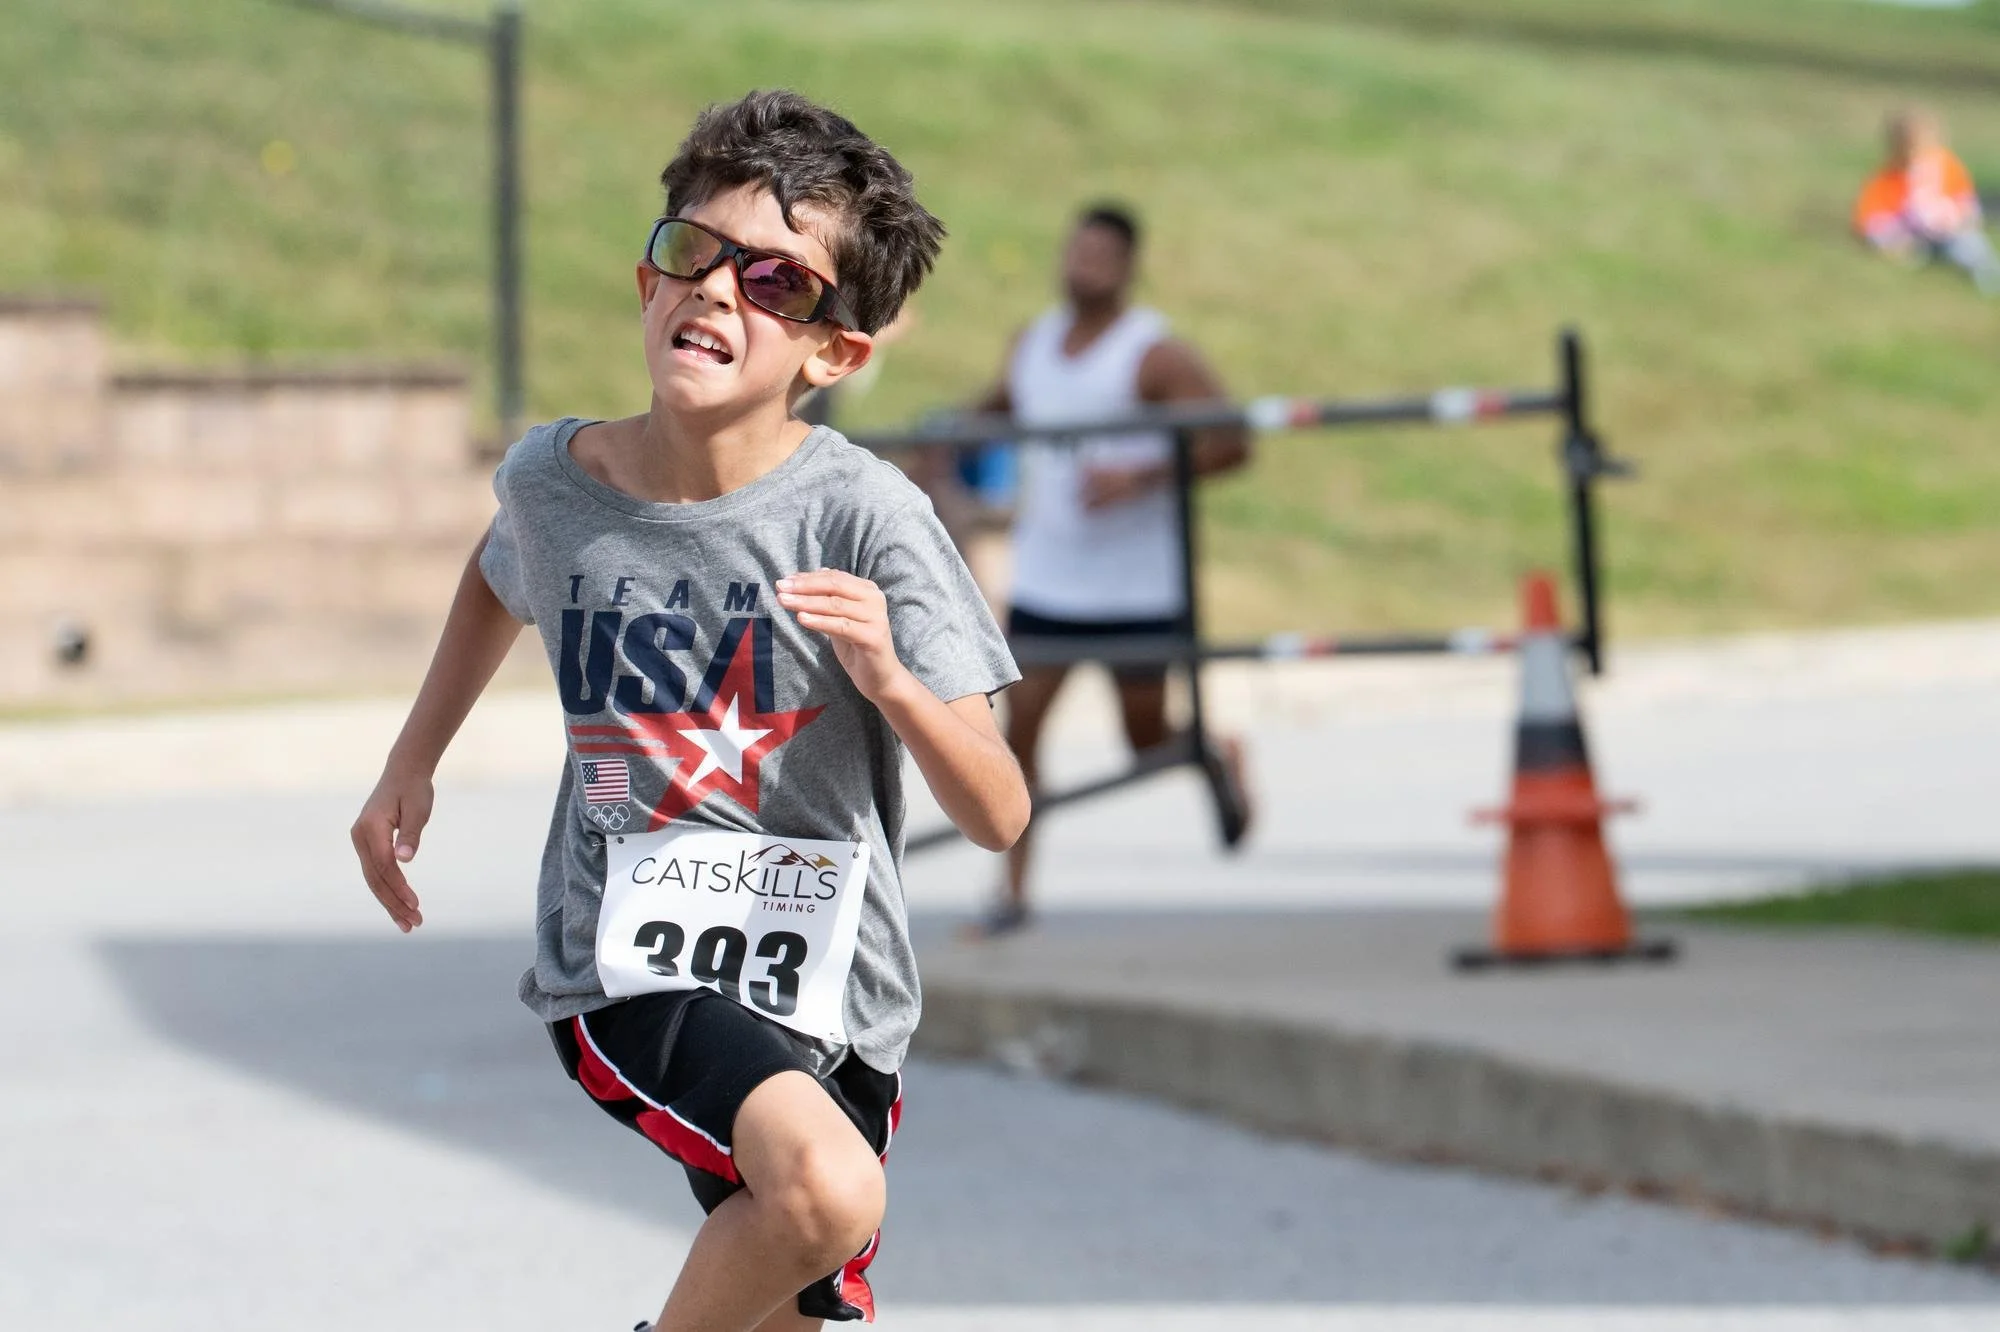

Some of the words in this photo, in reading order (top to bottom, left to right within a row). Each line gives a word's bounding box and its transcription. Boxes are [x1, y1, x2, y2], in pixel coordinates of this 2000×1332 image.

[568, 574, 761, 612] TEAM
[559, 609, 775, 715] USA
[762, 901, 816, 914] TIMING
[633, 920, 808, 1017] 393
